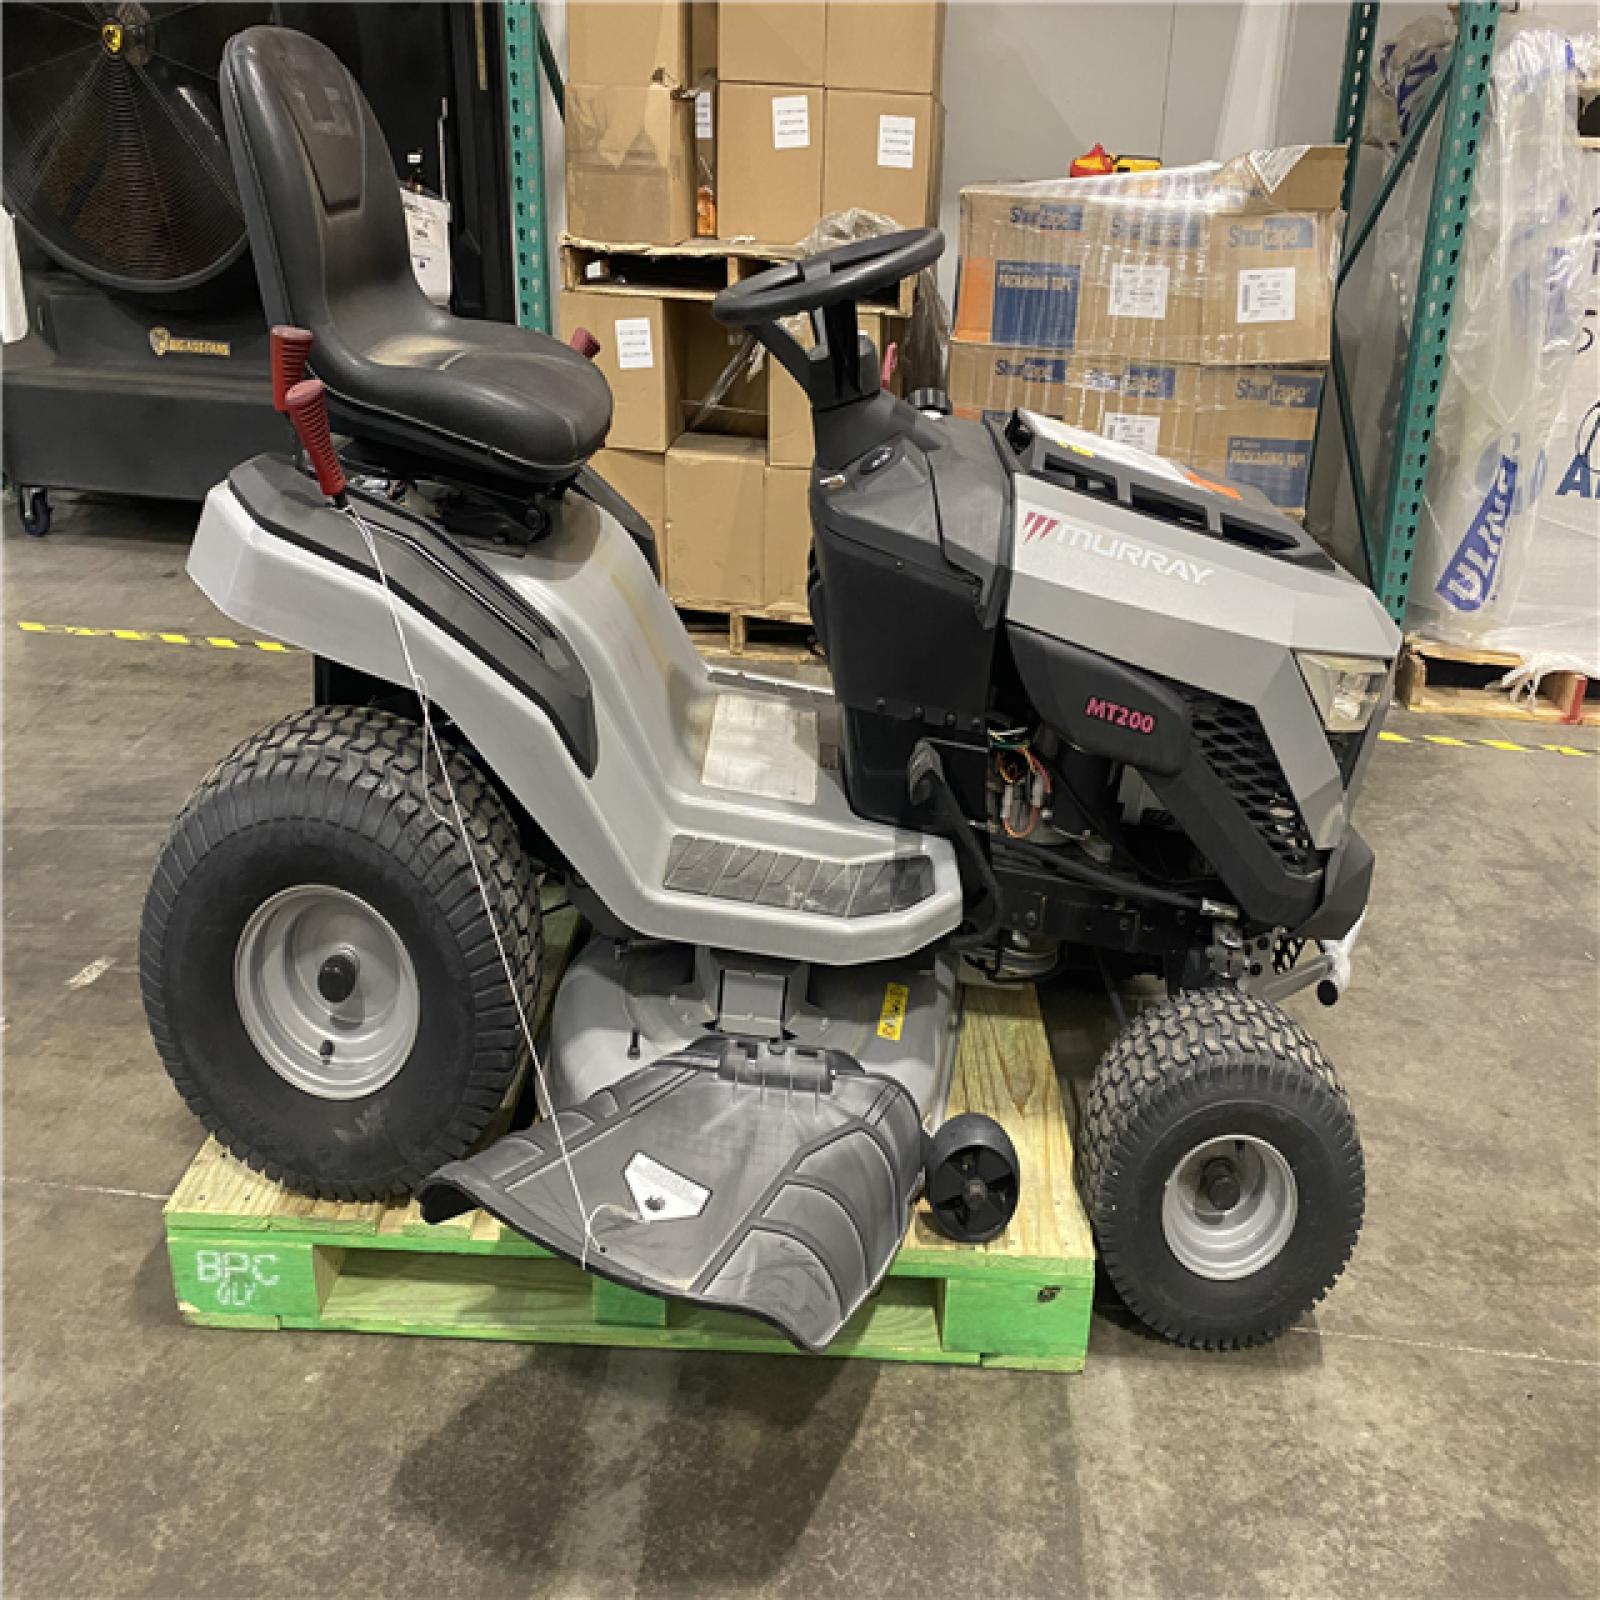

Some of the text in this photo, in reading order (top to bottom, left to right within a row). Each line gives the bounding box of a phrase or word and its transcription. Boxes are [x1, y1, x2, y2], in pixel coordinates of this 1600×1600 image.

[1555, 452, 1600, 500] A
[1056, 523, 1214, 586] MURRAY
[1086, 696, 1155, 734] MT200
[196, 1250, 281, 1286] BPC
